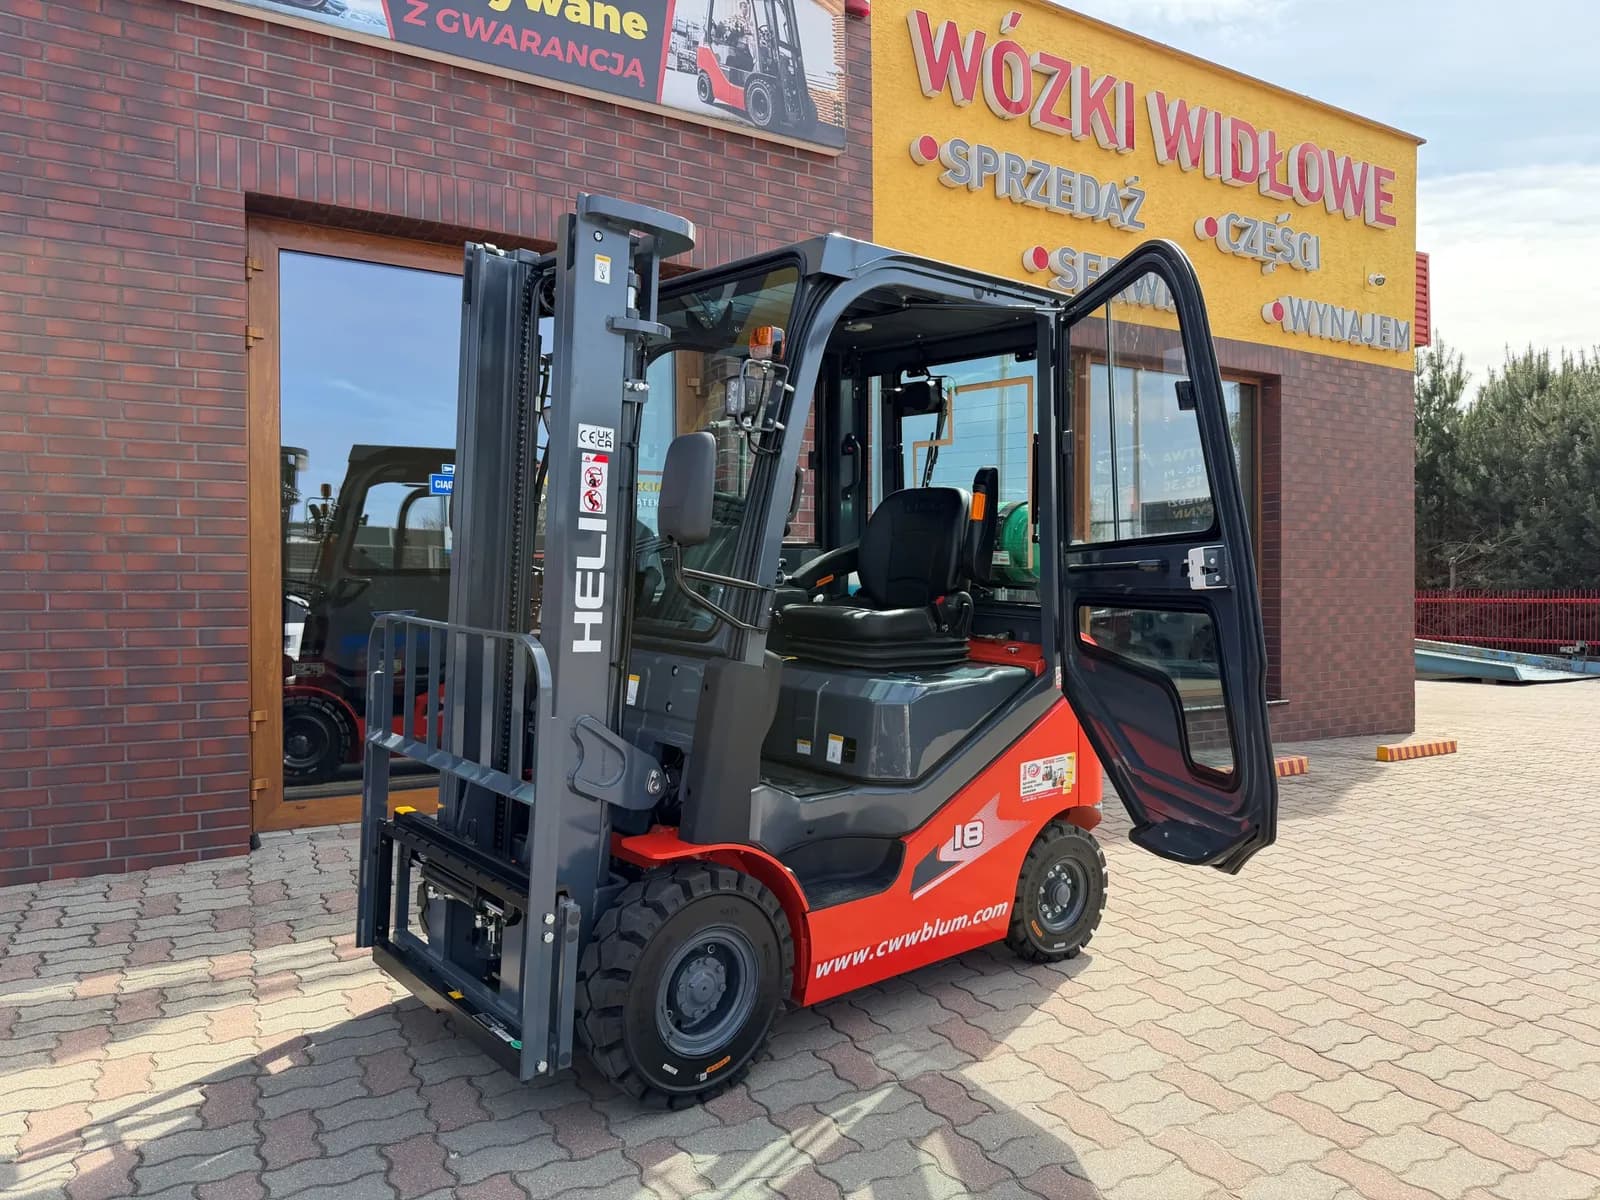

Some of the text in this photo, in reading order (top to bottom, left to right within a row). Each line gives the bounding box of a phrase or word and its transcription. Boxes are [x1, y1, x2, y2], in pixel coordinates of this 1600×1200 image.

[403, 0, 646, 88] Z GWARANCJĄ
[908, 9, 1397, 229] WÓZKI WIDŁOWE
[939, 138, 1146, 232] SPRZEDAŻ
[1049, 246, 1177, 311] SEWI
[1216, 212, 1320, 275] CZĘŚCI
[1281, 296, 1410, 352] WYNAJEM
[579, 430, 596, 444] CE
[572, 517, 608, 652] HELI
[953, 819, 985, 851] 18
[815, 901, 1009, 979] www.cwwblum.com
